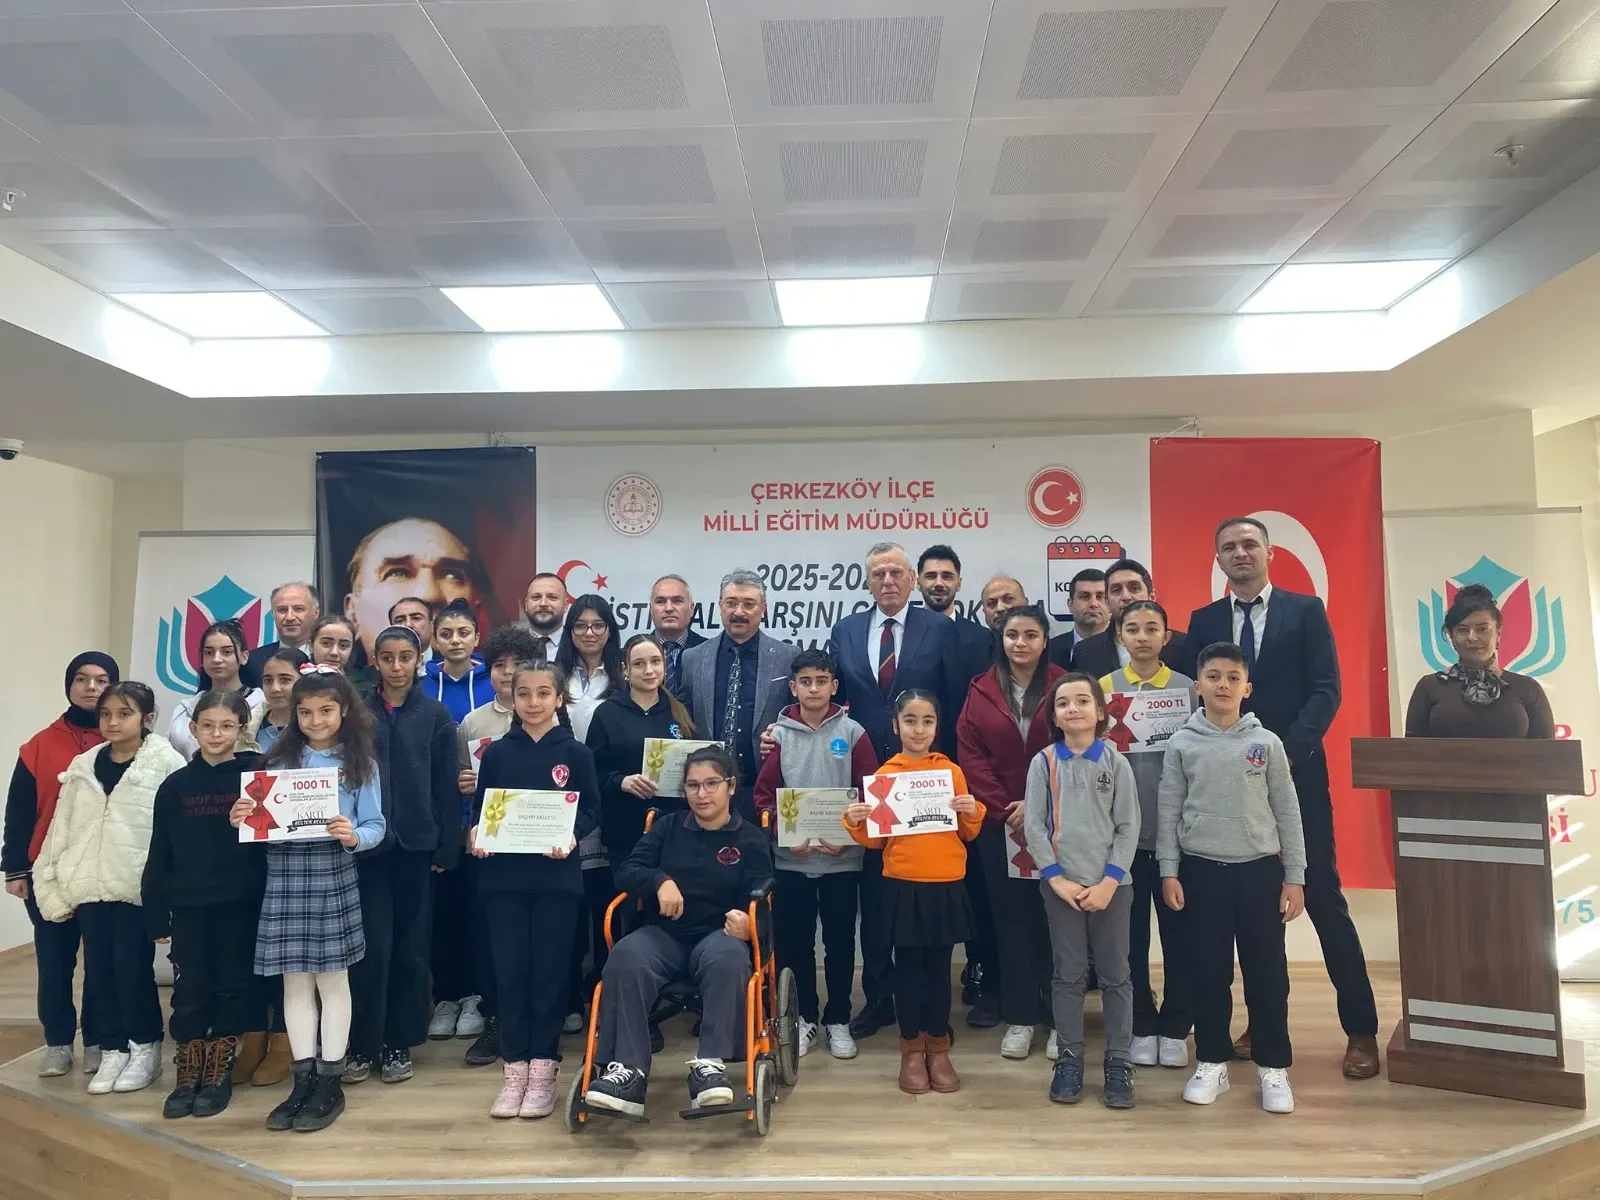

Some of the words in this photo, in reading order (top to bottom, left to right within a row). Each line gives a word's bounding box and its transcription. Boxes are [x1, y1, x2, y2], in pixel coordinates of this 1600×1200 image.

[750, 477, 882, 505] ÇERKEZKÖY
[888, 476, 935, 503] İLÇE
[703, 509, 760, 532] MİLLİ
[766, 509, 840, 531] EĞİTİM
[846, 507, 989, 531] MÜDÜRLÜĞÜ
[756, 562, 872, 592] 2025-20
[1146, 700, 1173, 709] 2000
[1175, 699, 1186, 707] TL
[292, 780, 318, 790] 1000
[319, 779, 331, 789] TL
[909, 780, 935, 789] 2000
[937, 779, 948, 787] TL
